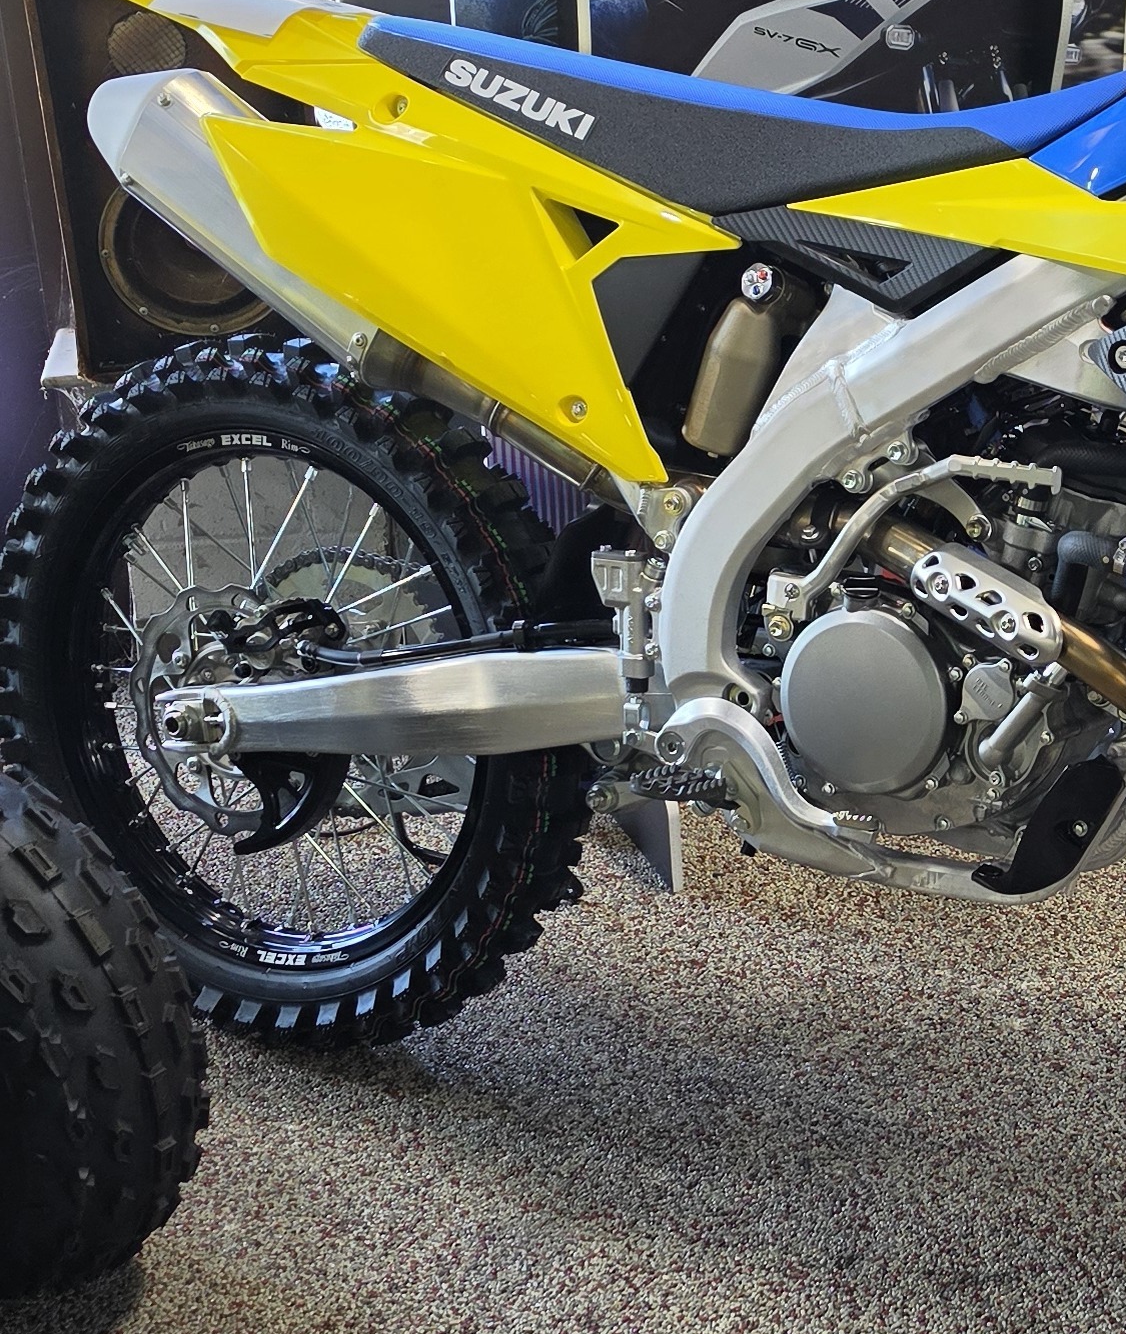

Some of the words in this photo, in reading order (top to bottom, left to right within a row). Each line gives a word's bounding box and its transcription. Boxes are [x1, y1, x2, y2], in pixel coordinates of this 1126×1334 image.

[753, 26, 842, 59] SV-7GX
[444, 59, 596, 141] SUZUKI
[220, 434, 272, 448] EXCEL
[281, 438, 311, 454] Rim
[256, 949, 306, 966] EXCEL
